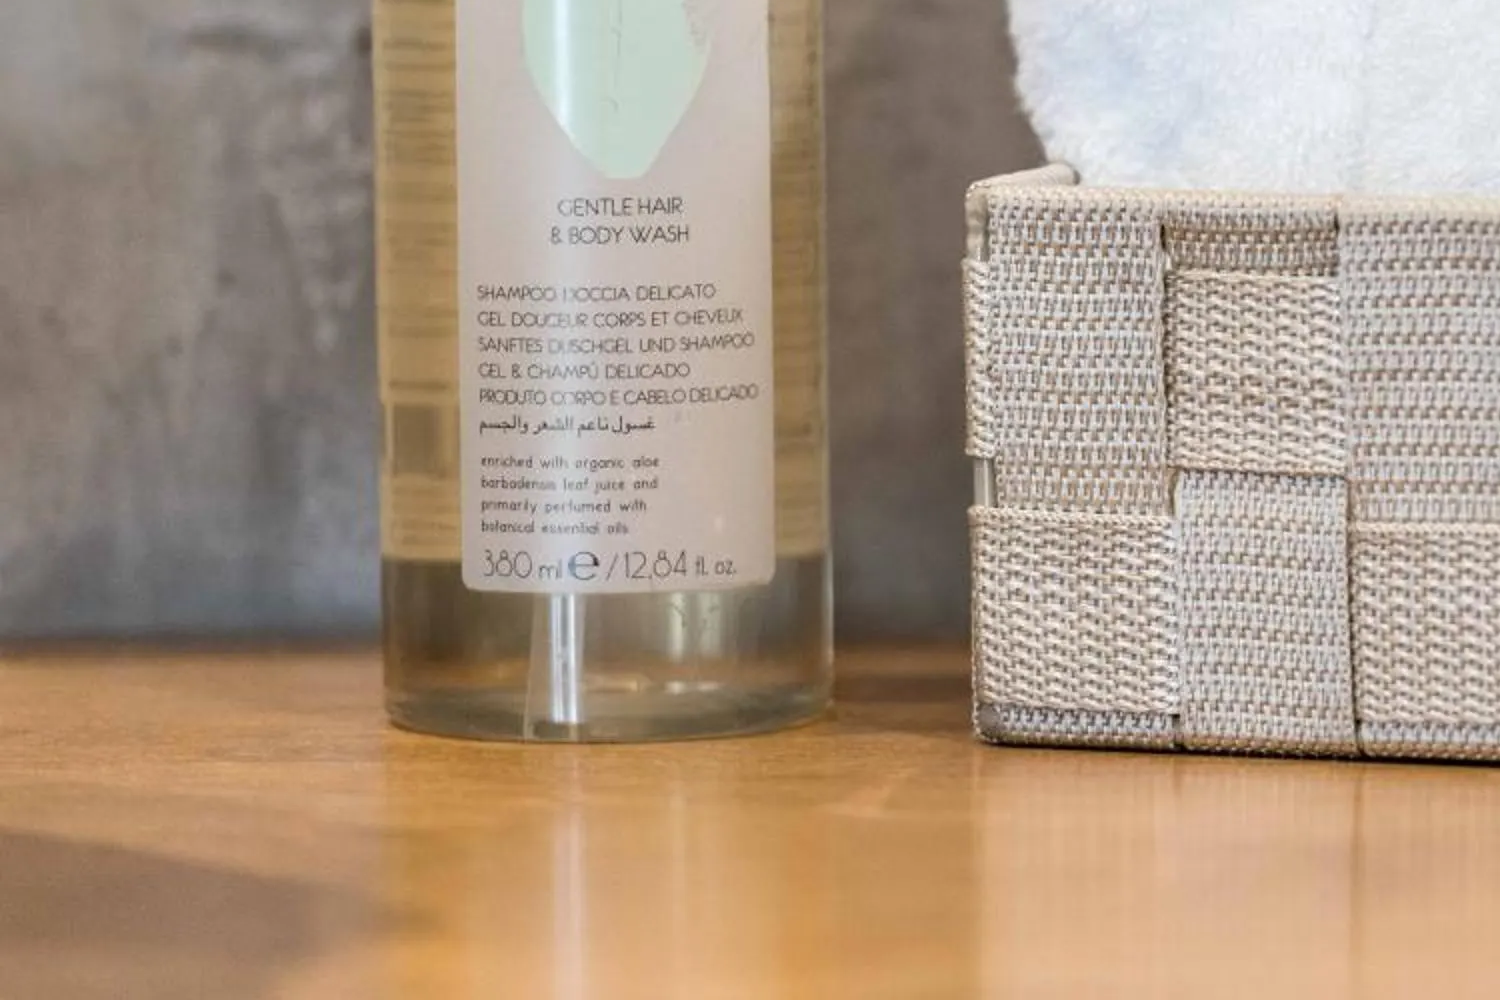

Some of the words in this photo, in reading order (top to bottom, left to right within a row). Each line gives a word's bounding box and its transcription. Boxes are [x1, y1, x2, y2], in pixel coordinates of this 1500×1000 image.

[557, 198, 633, 217] GENTLE
[637, 196, 684, 217] HAIR
[551, 226, 562, 245] &
[569, 226, 624, 245] BODY
[630, 224, 690, 243] WASH
[477, 285, 557, 301] SHAMPOO
[636, 283, 716, 301] DELICATO
[477, 311, 506, 327] GEL
[511, 311, 588, 328] DOUCEUR
[593, 311, 646, 328] CORPS
[651, 311, 669, 328] ET
[674, 308, 743, 326] CHEVEUX
[478, 337, 543, 353] SANFTES
[639, 337, 675, 353] UND
[679, 332, 755, 351] SHAMPOO
[477, 362, 506, 379] GEL
[511, 362, 522, 379] &
[605, 362, 690, 379] DELICADO
[479, 388, 546, 406] PRODUTO
[550, 390, 606, 406] CORPO
[610, 388, 620, 406] E
[623, 388, 686, 405] CABELO
[689, 383, 759, 404] DELICADO
[480, 455, 533, 469] enriched
[539, 456, 569, 470] with
[575, 457, 625, 473] organic
[632, 455, 660, 470] aloe
[563, 477, 589, 492] leaf
[593, 479, 625, 495] juice
[633, 476, 658, 490] and
[480, 499, 537, 514] primarily
[544, 500, 611, 514] perfumed
[619, 499, 647, 513] with
[480, 520, 535, 534] botanical
[541, 521, 600, 535] essential
[607, 520, 629, 535] oils
[482, 549, 533, 579] 380
[538, 559, 562, 581] ml
